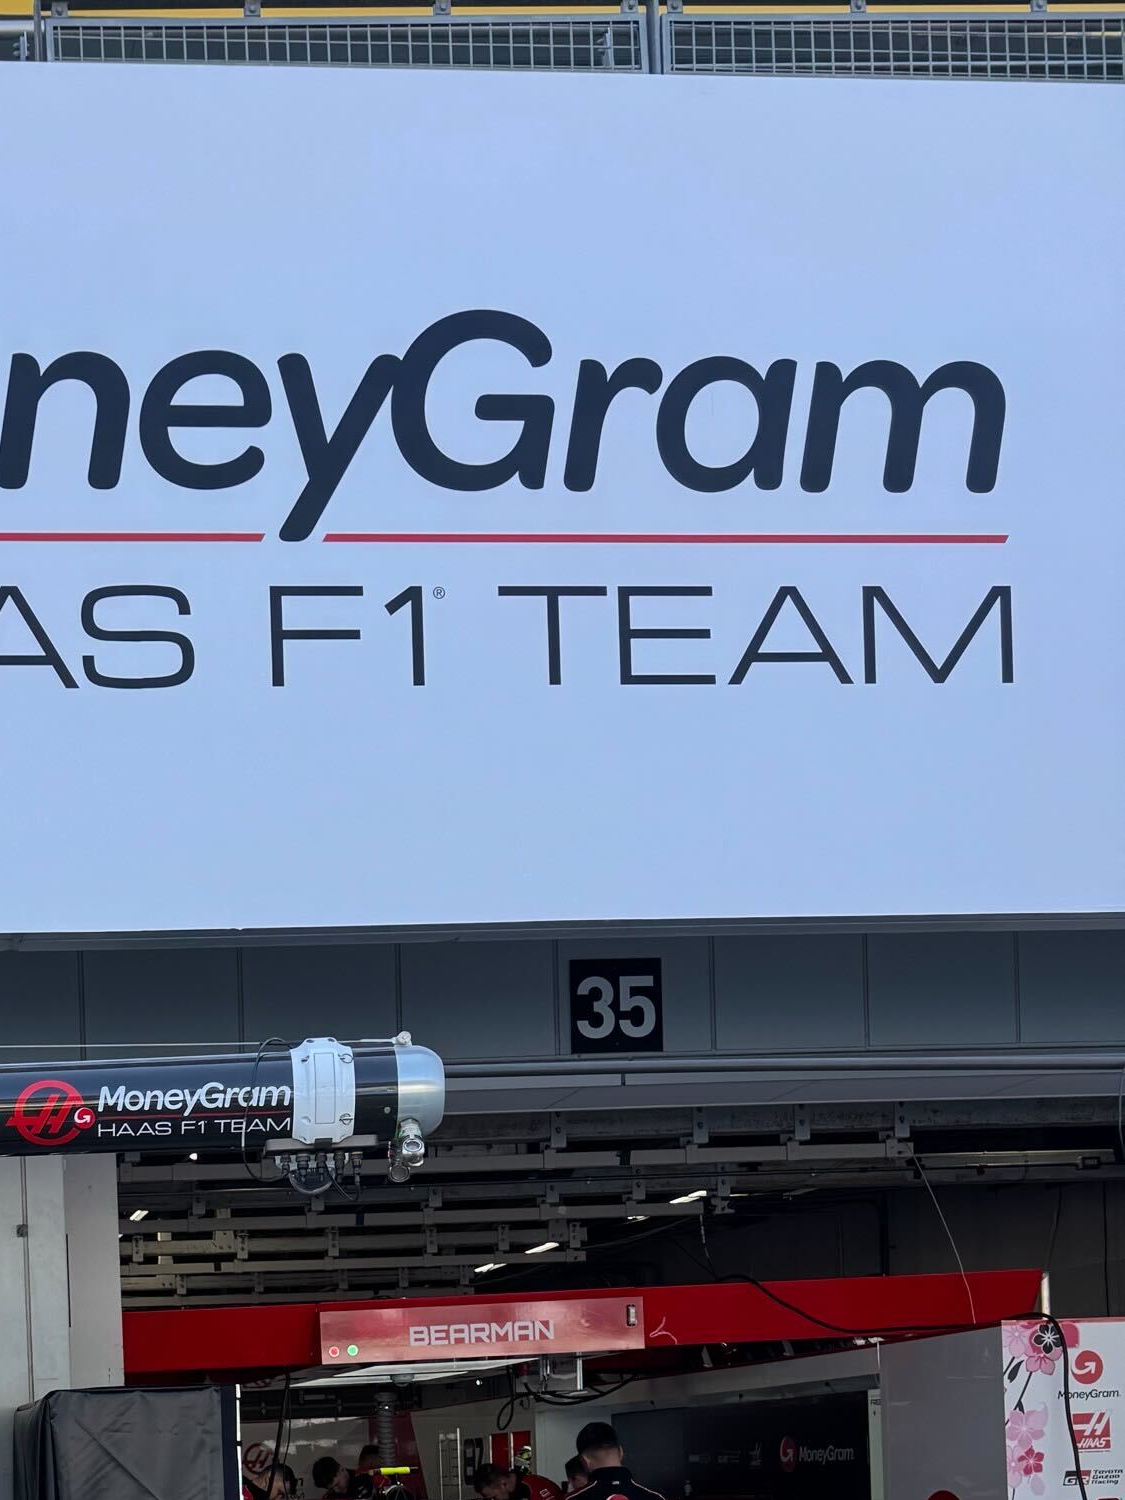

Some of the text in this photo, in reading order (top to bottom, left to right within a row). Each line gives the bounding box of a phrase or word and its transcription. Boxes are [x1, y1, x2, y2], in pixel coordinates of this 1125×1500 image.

[498, 585, 1013, 686] TEAM
[577, 976, 656, 1039] 35
[97, 1082, 291, 1116] MoneyGram
[98, 1121, 172, 1137] HAAS
[214, 1118, 291, 1133] TEAM
[409, 1319, 555, 1346] BEARMAN
[799, 1446, 854, 1464] MoneyGram
